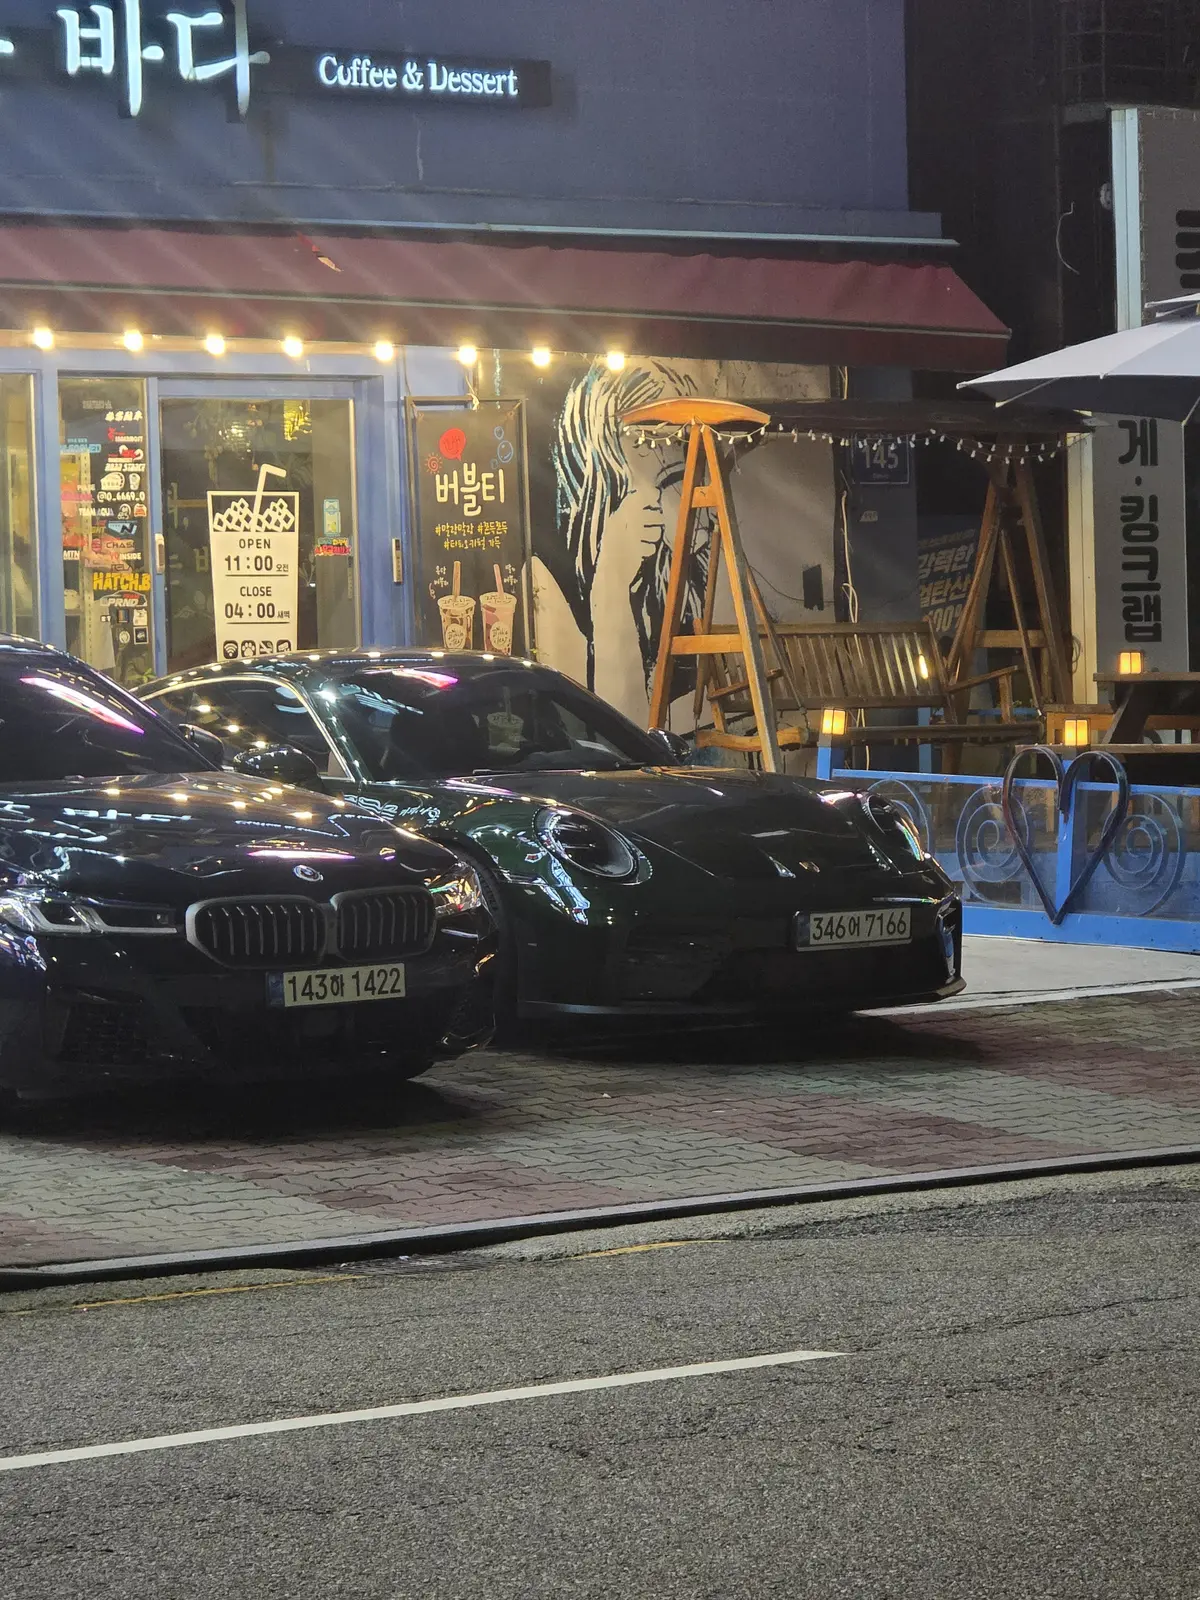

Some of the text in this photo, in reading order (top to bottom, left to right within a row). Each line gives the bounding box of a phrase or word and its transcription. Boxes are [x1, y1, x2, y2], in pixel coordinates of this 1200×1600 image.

[318, 54, 520, 97] Coffee & Dessert
[861, 443, 899, 469] 145
[435, 462, 505, 517] 버블티
[238, 538, 271, 549] OPEN
[224, 555, 273, 571] 11:00
[239, 586, 272, 597] CLOSE
[224, 602, 276, 619] 04:00
